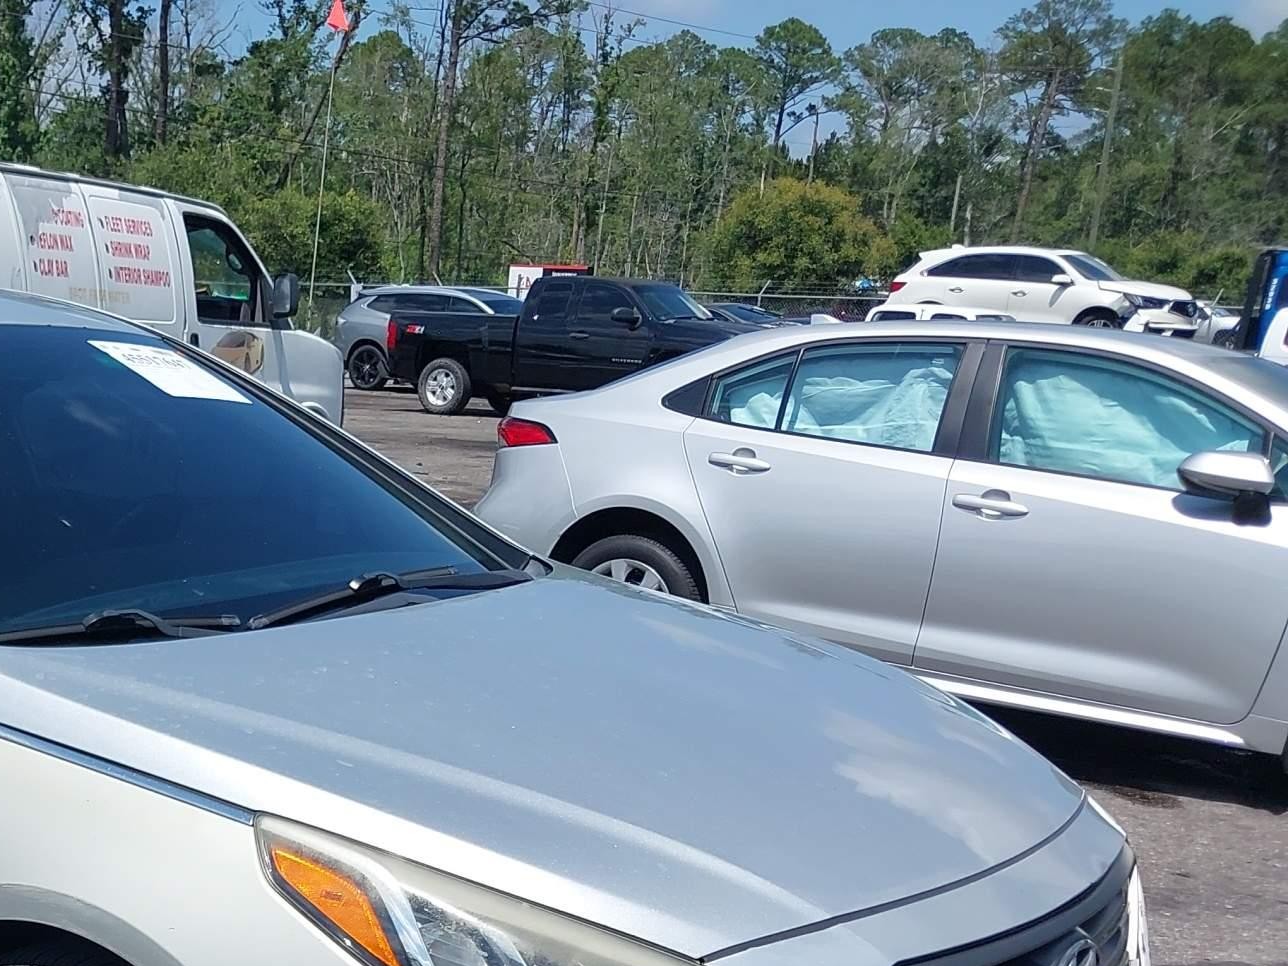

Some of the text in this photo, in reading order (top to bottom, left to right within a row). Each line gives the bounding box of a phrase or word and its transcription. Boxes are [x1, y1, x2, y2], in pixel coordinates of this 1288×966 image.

[104, 216, 153, 237] FLEET SERVICES
[58, 235, 74, 252] WAX
[110, 241, 150, 260] SHRINK WRAP
[38, 258, 70, 278] CLAY BAR
[114, 266, 171, 288] INTERIOR SHAMPOO
